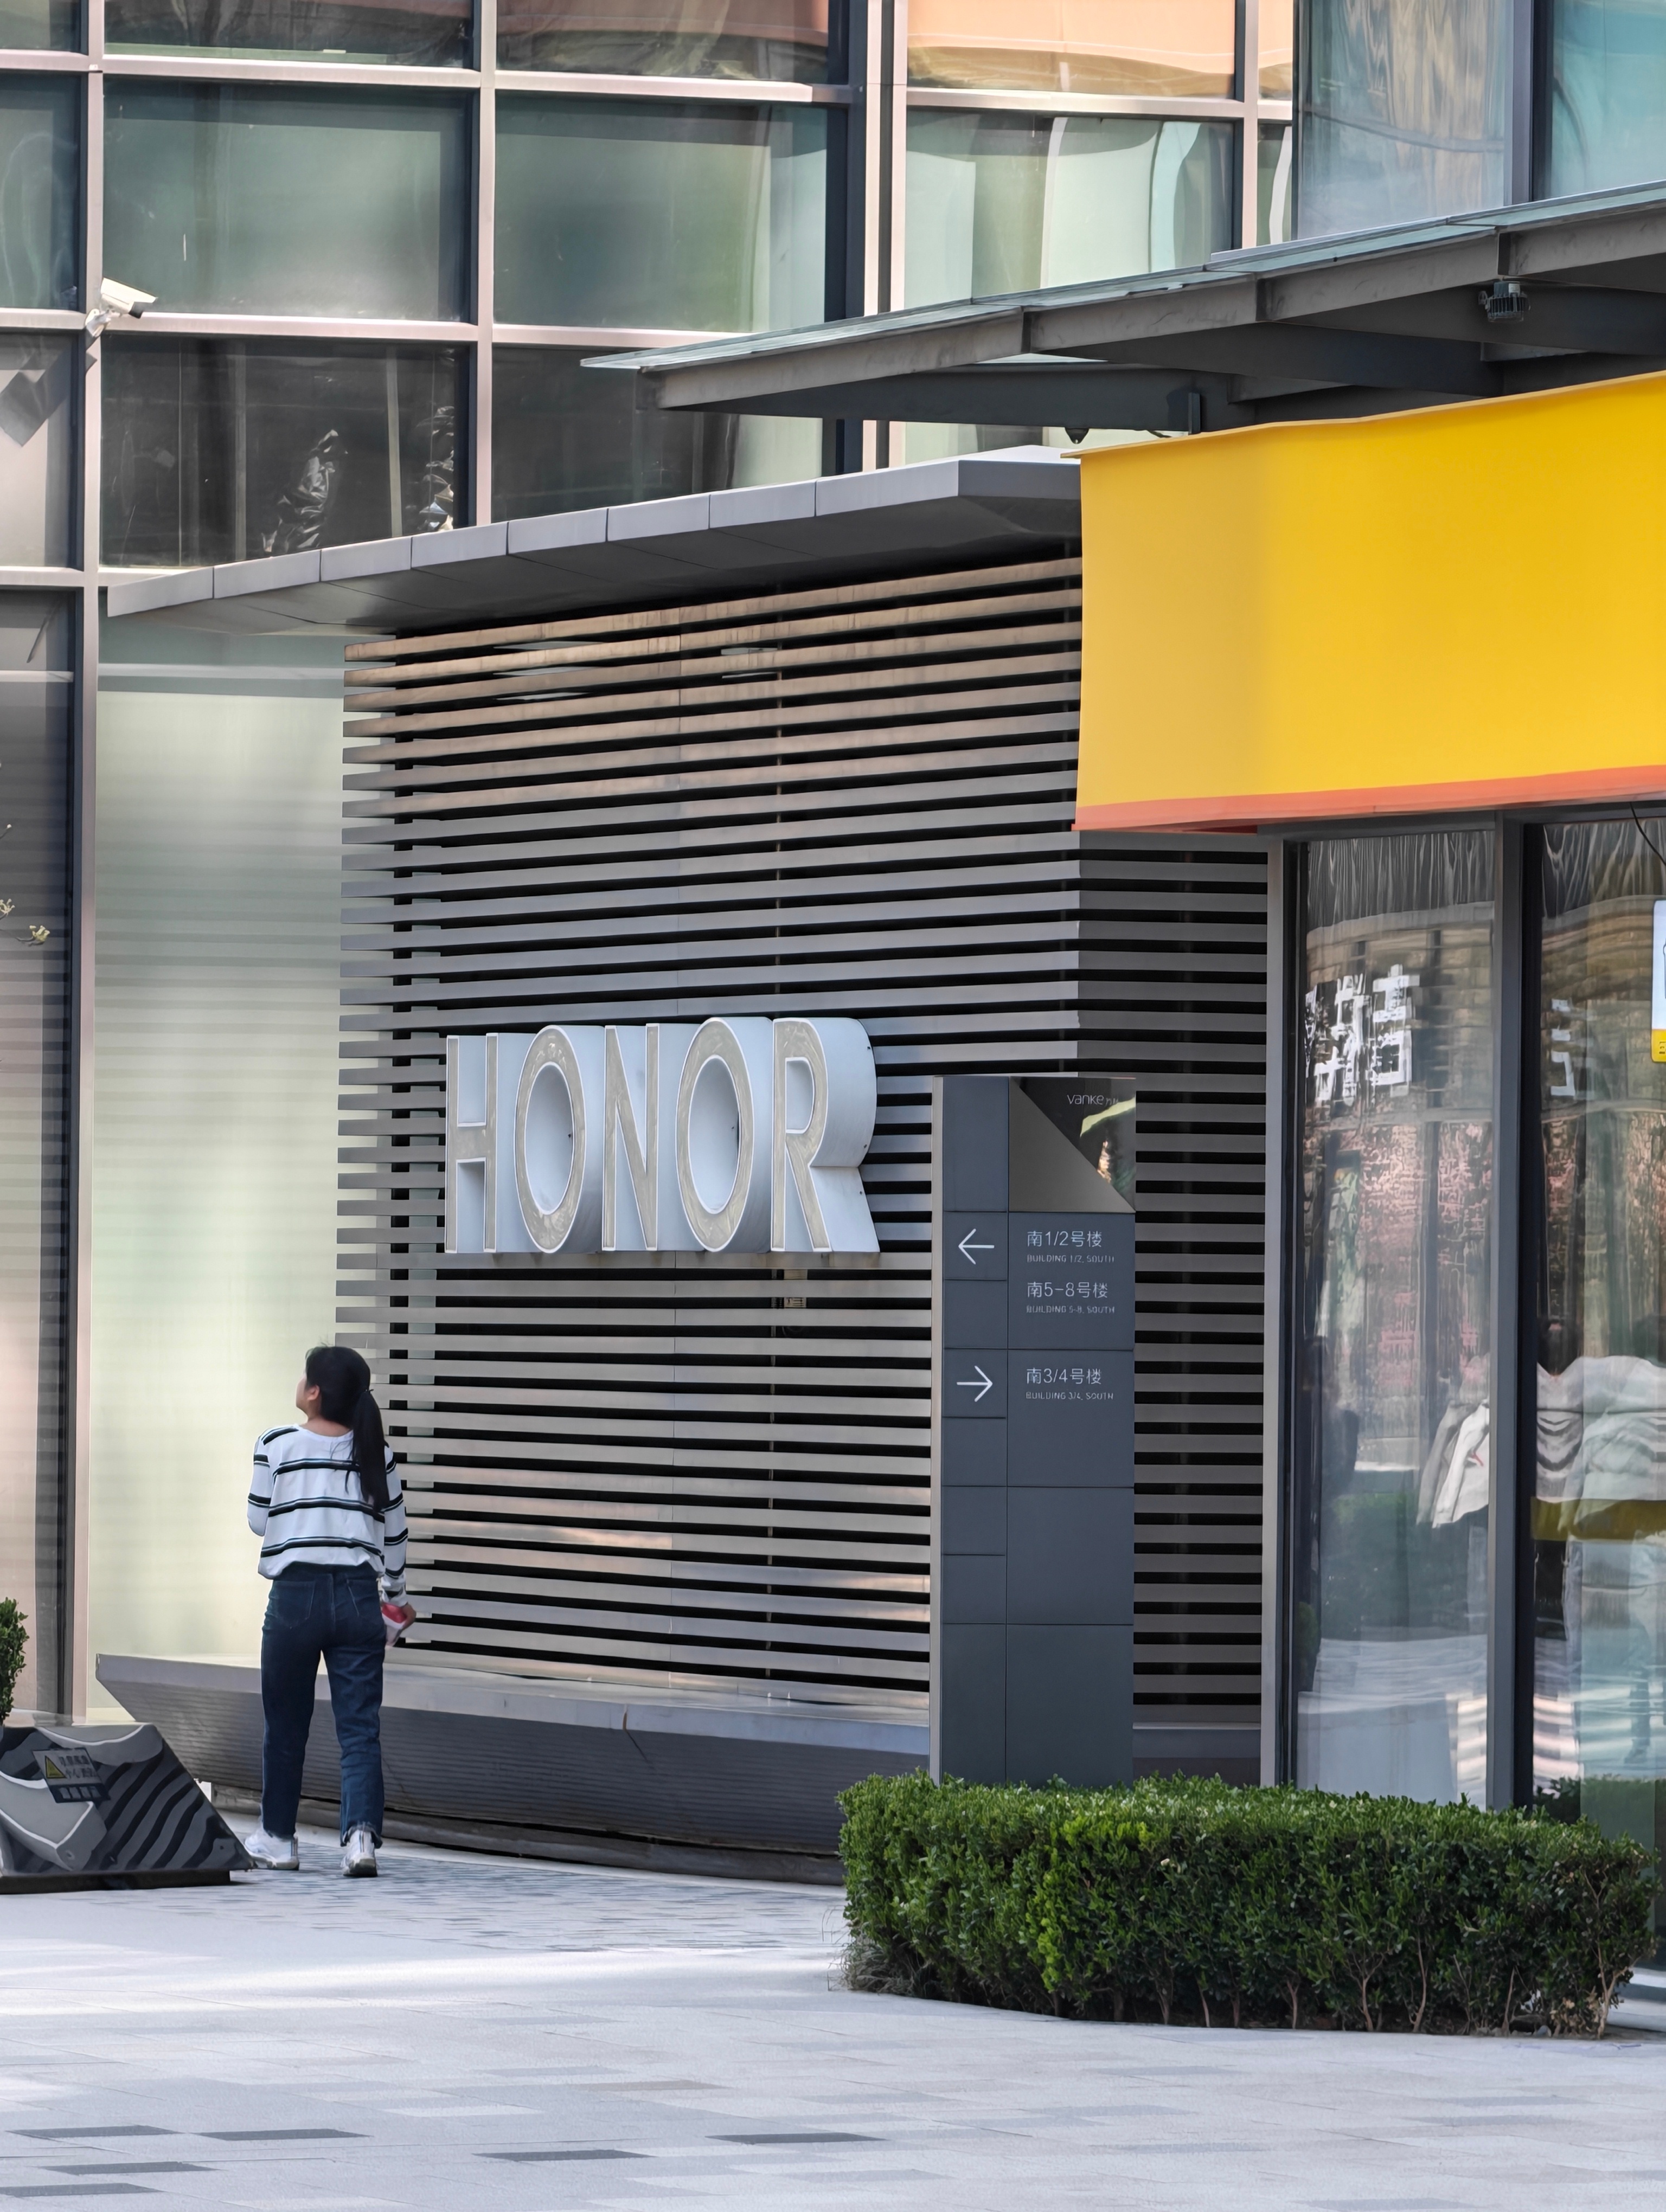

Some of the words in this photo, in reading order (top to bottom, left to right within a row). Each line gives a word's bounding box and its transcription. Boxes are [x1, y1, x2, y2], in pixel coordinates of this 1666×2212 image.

[445, 1017, 880, 1254] HONOR
[1027, 1230, 1103, 1248] 南1/2号楼
[1027, 1254, 1067, 1263] BUILDING
[1087, 1255, 1114, 1263] SOUTH
[1027, 1281, 1108, 1298] 南5-8号楼
[1026, 1305, 1067, 1314] BUILDING
[1087, 1306, 1115, 1314] SOUTH
[1026, 1367, 1102, 1385] 南3/4号楼
[1026, 1391, 1066, 1400] BUILDING
